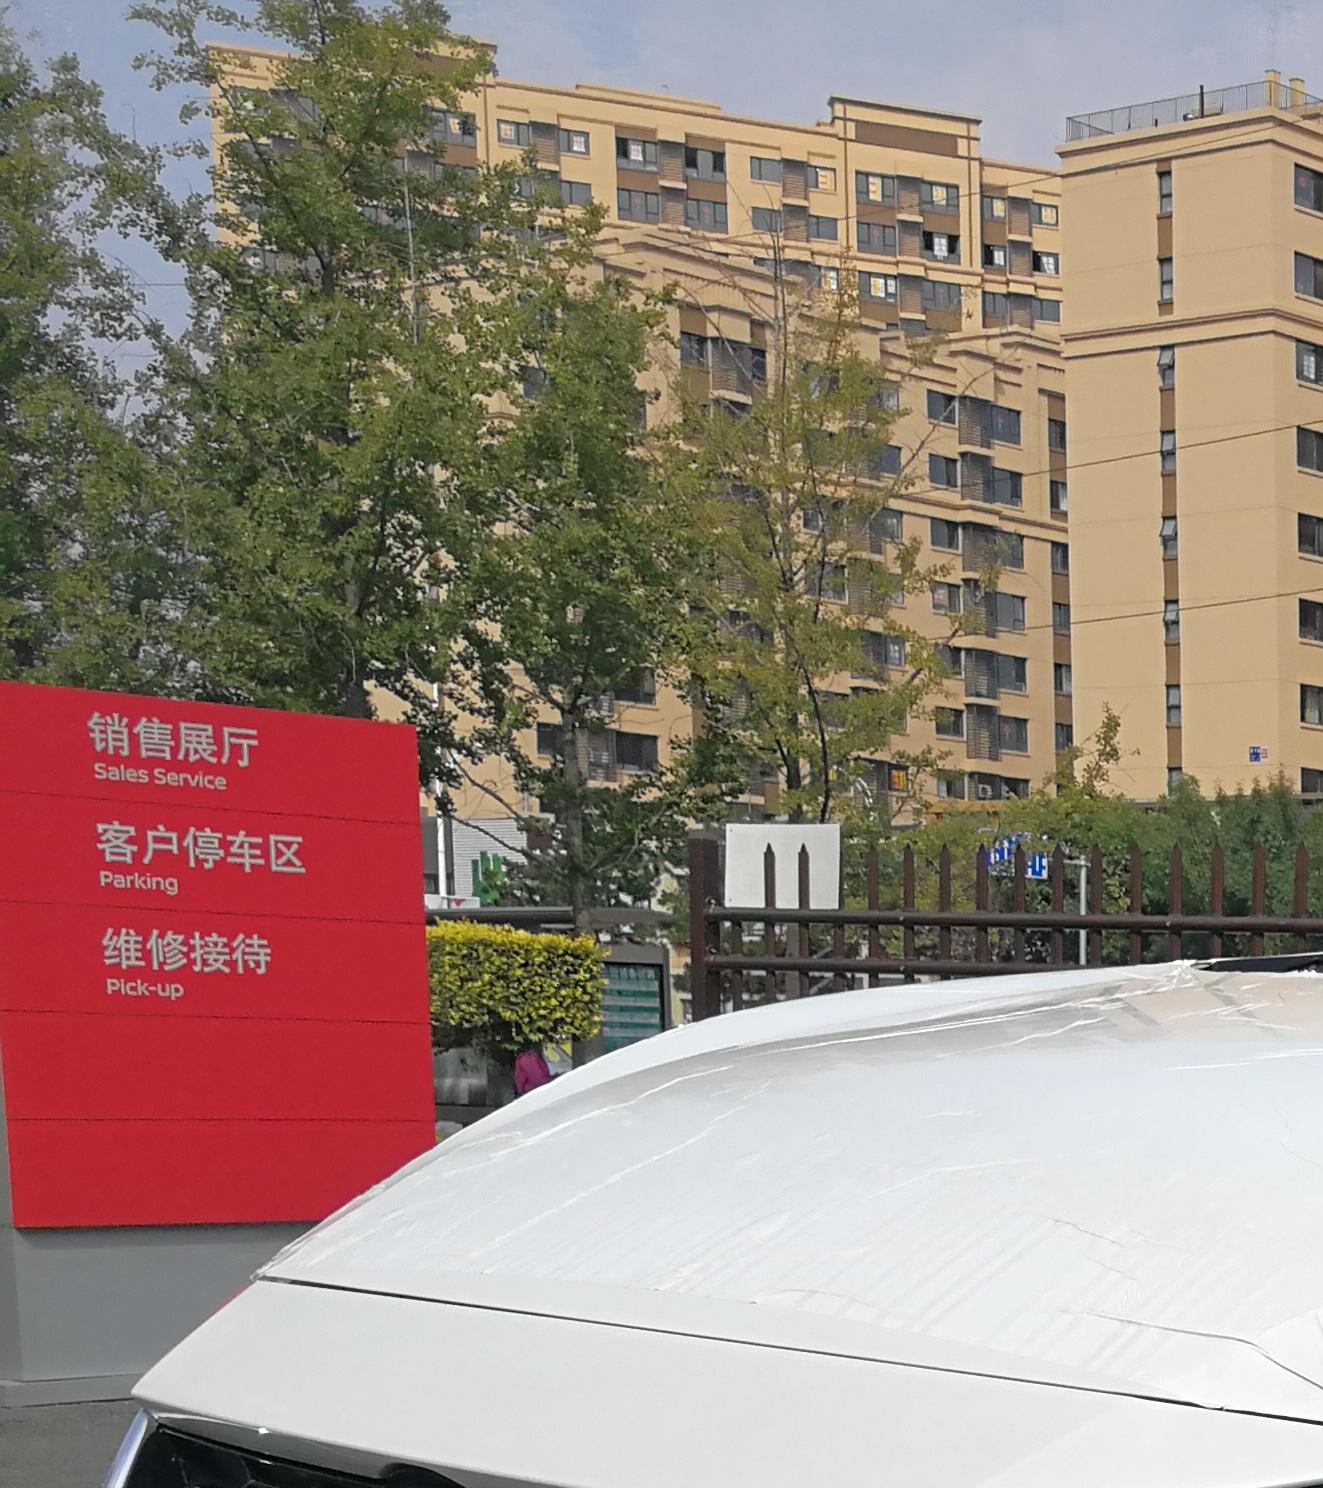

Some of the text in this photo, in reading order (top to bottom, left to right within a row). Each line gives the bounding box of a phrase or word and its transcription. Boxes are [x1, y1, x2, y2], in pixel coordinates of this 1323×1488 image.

[87, 711, 259, 767] 销售展厅
[94, 763, 227, 791] Sales Service
[96, 821, 306, 874] 客户停车区
[100, 870, 179, 895] Parking
[102, 928, 272, 975] 维修接待
[106, 977, 184, 1000] Pick-up
